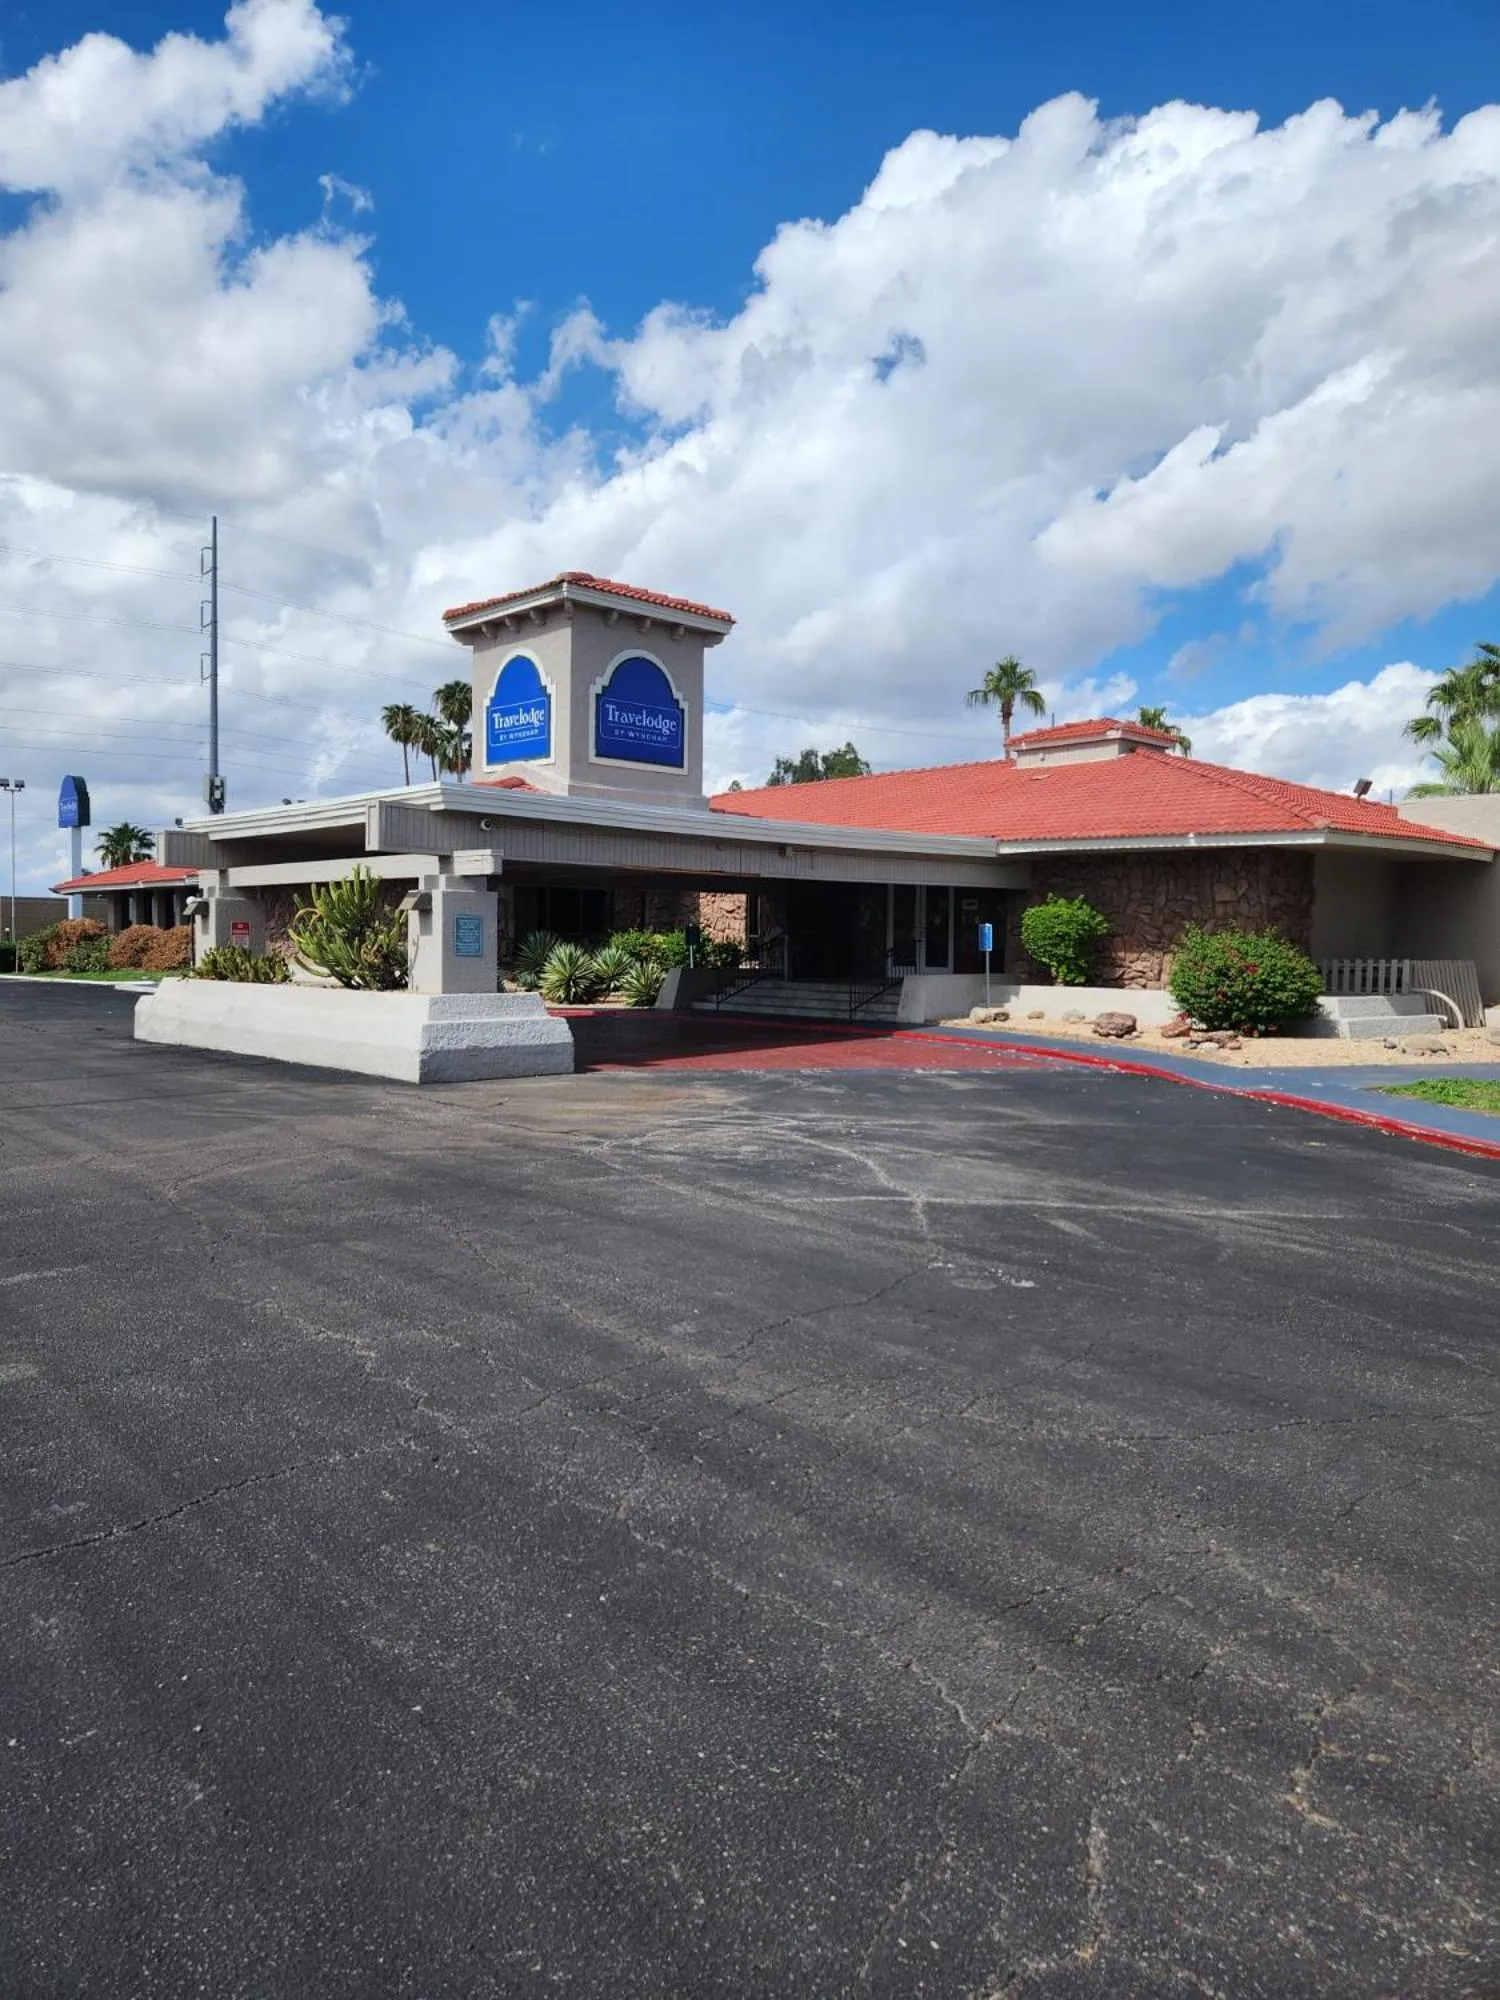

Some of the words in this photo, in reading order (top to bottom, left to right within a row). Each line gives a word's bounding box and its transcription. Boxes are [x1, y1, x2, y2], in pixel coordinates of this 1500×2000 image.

[492, 707, 545, 729] Travelodge
[605, 704, 676, 735] Travelodge
[614, 729, 625, 737] BY
